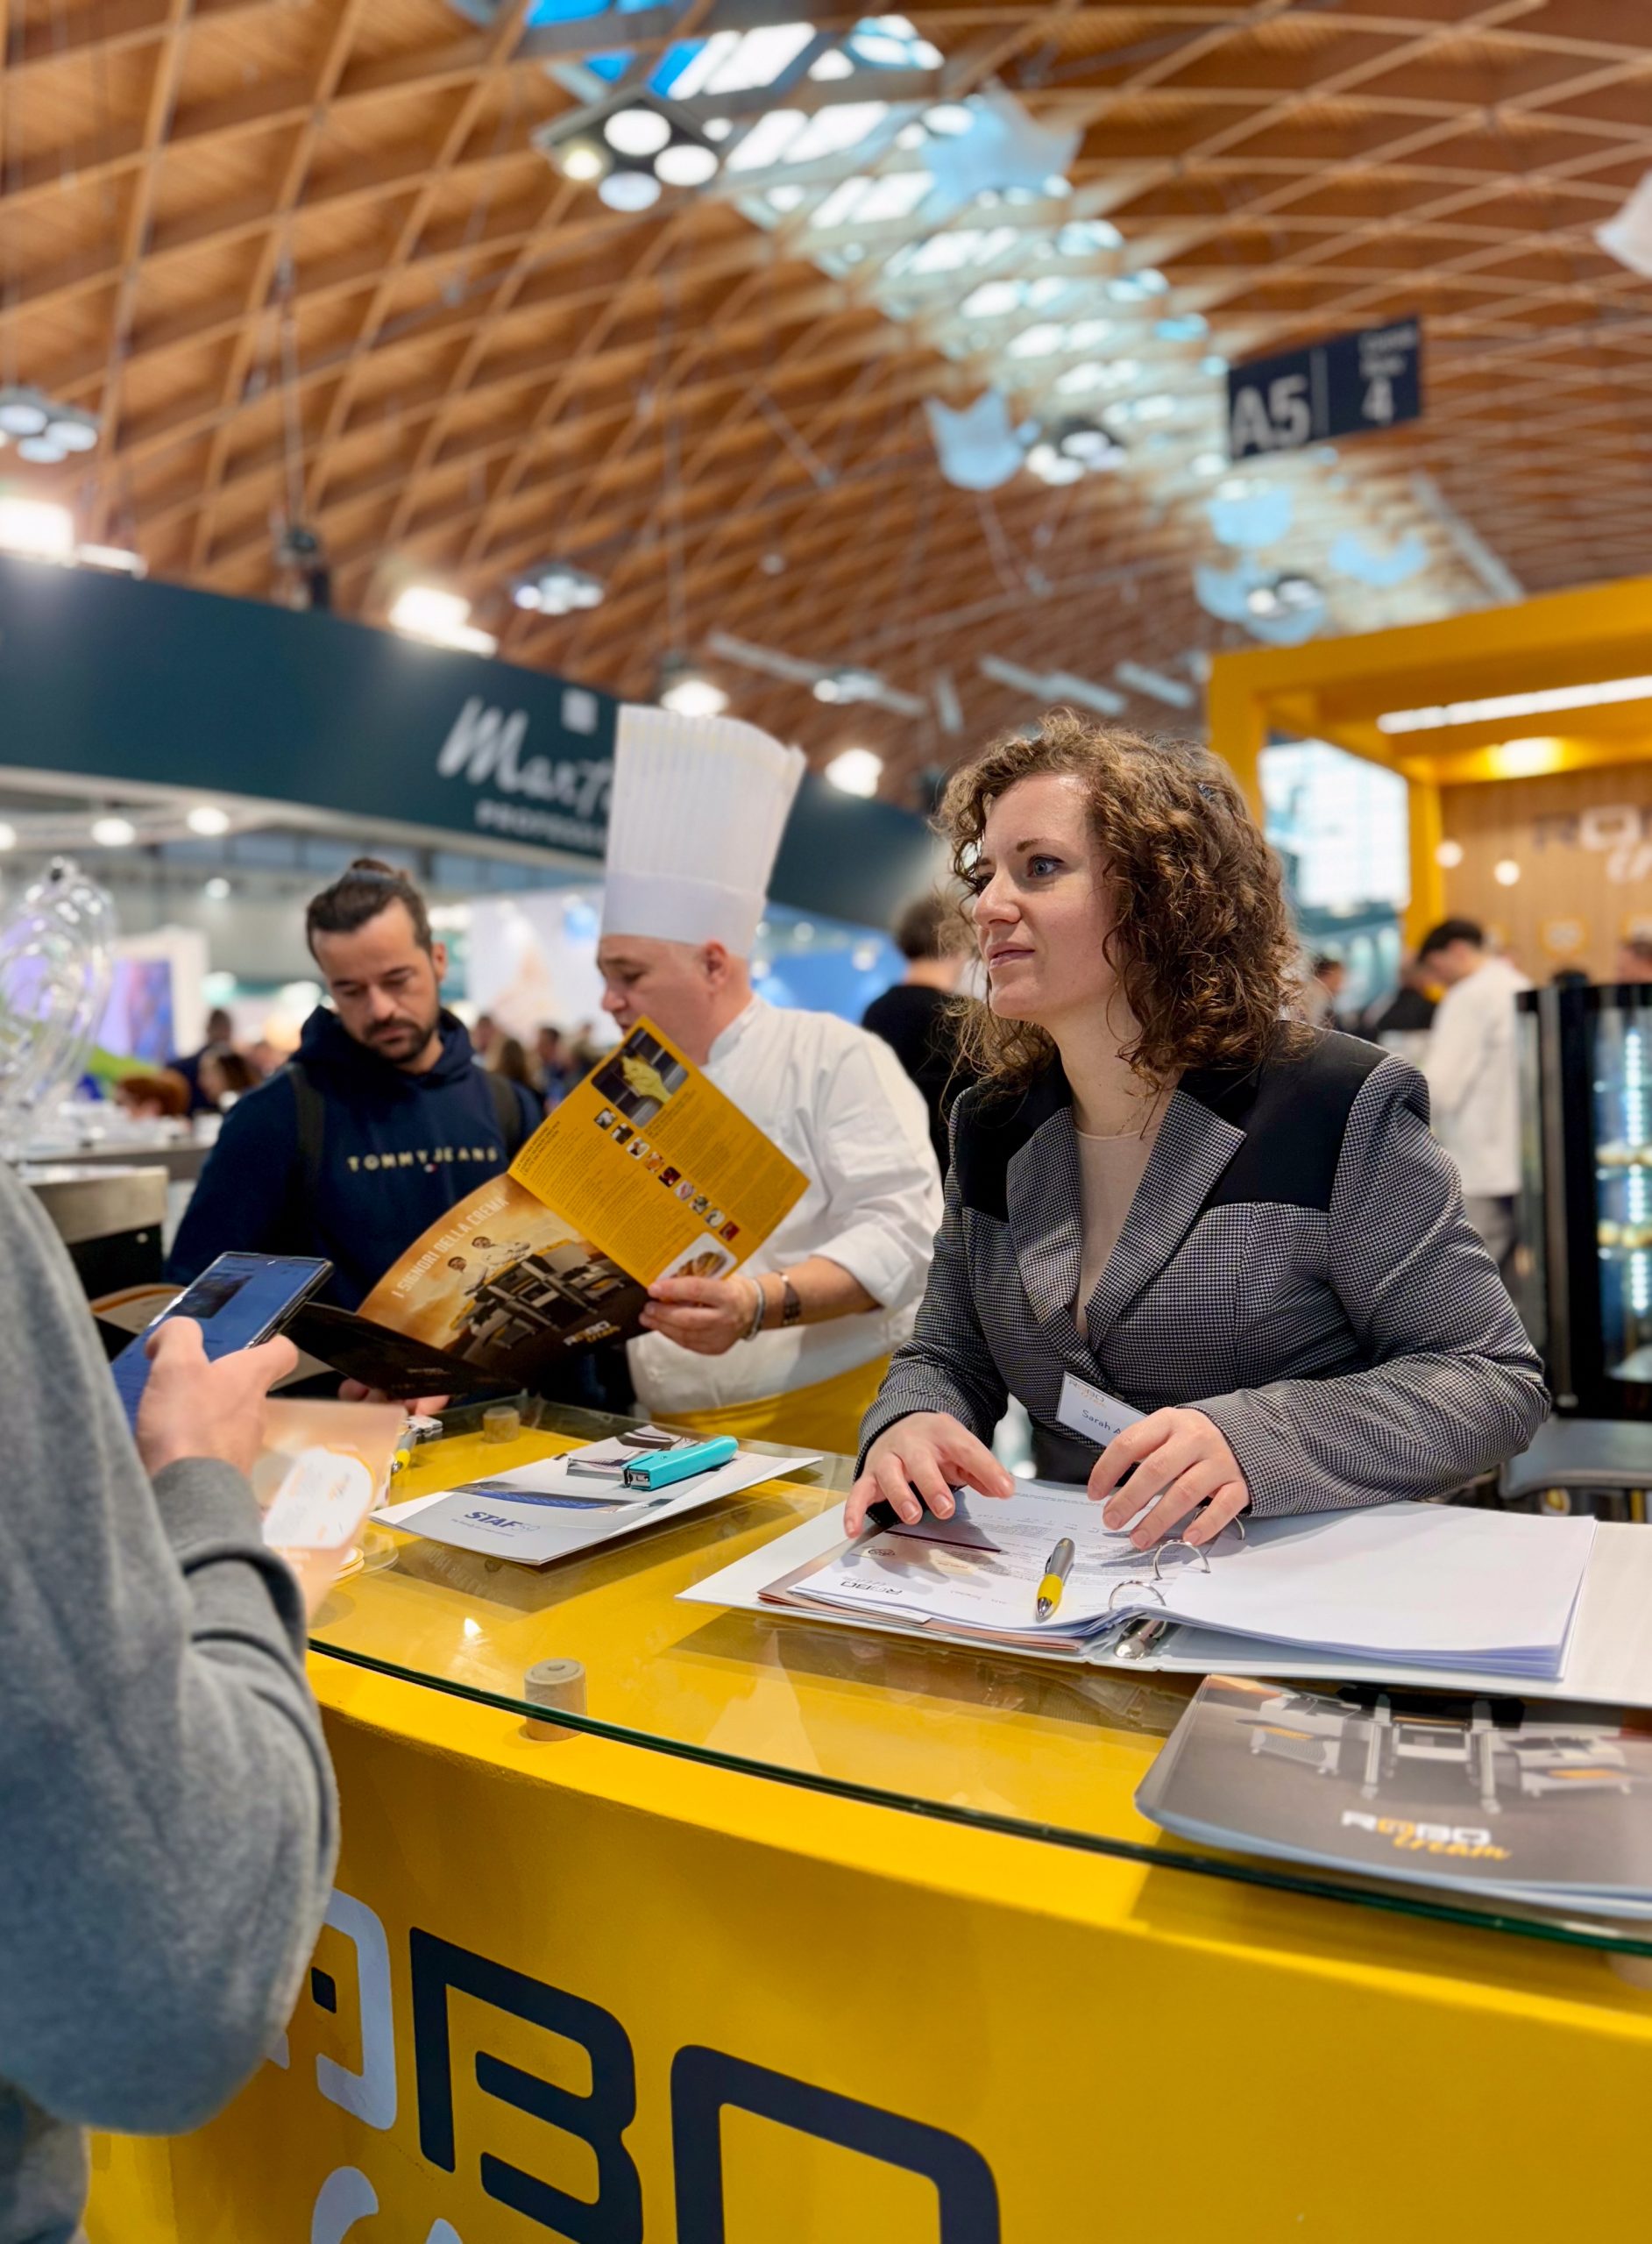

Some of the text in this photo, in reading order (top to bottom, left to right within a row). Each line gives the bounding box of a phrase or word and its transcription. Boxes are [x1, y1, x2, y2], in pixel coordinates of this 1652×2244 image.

[1230, 373, 1311, 458] A5
[347, 1146, 499, 1173] TOMMY JEANS
[396, 1250, 440, 1292] SIGNORI
[433, 1222, 472, 1253] DELLA
[465, 1195, 509, 1225] CREMA
[1081, 1409, 1111, 1431] Sarah
